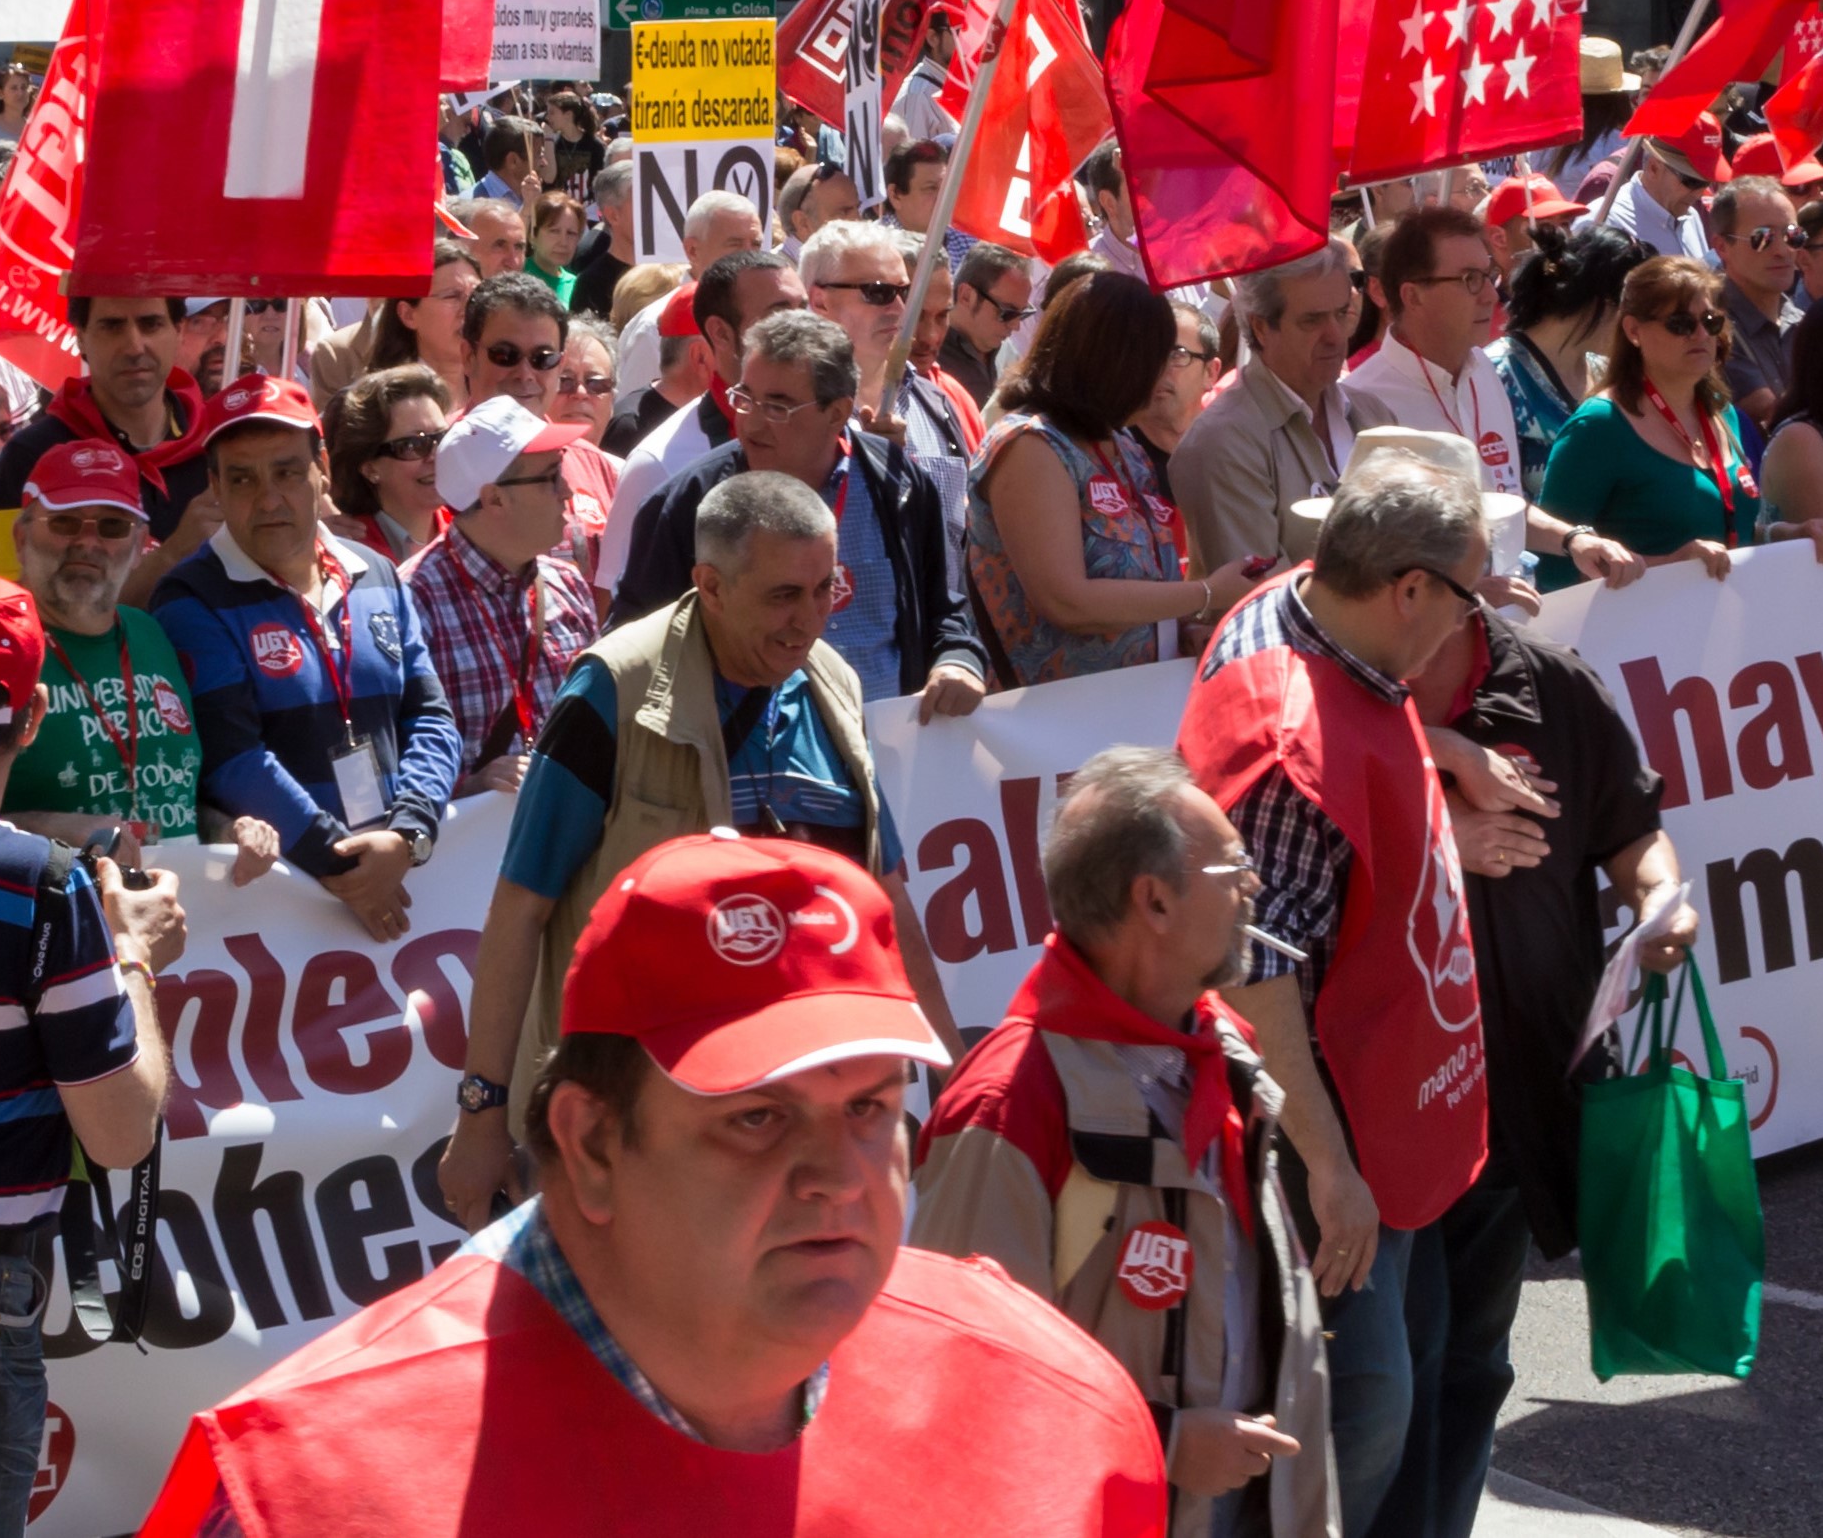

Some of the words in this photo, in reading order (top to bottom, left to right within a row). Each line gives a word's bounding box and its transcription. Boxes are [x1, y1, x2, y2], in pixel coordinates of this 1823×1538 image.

[523, 8, 547, 31] muy
[549, 4, 597, 32] grandes,
[684, 6, 710, 17] plaza
[715, 6, 727, 15] de
[732, 2, 770, 16] Colón
[521, 46, 528, 61] a
[529, 45, 548, 61] sus
[551, 43, 595, 63] votantes.
[635, 31, 696, 70] €-deuda
[700, 39, 719, 67] no
[723, 28, 775, 73] votada,
[634, 87, 687, 130] tiranía
[691, 88, 775, 130] descarada.
[254, 628, 292, 659] UGT
[716, 906, 774, 937] UGT
[153, 928, 483, 1142] pleo
[1727, 1063, 1760, 1088] drid
[135, 1164, 152, 1236] DIGITAL
[130, 1242, 146, 1281] EOS
[1128, 1232, 1189, 1269] UGT
